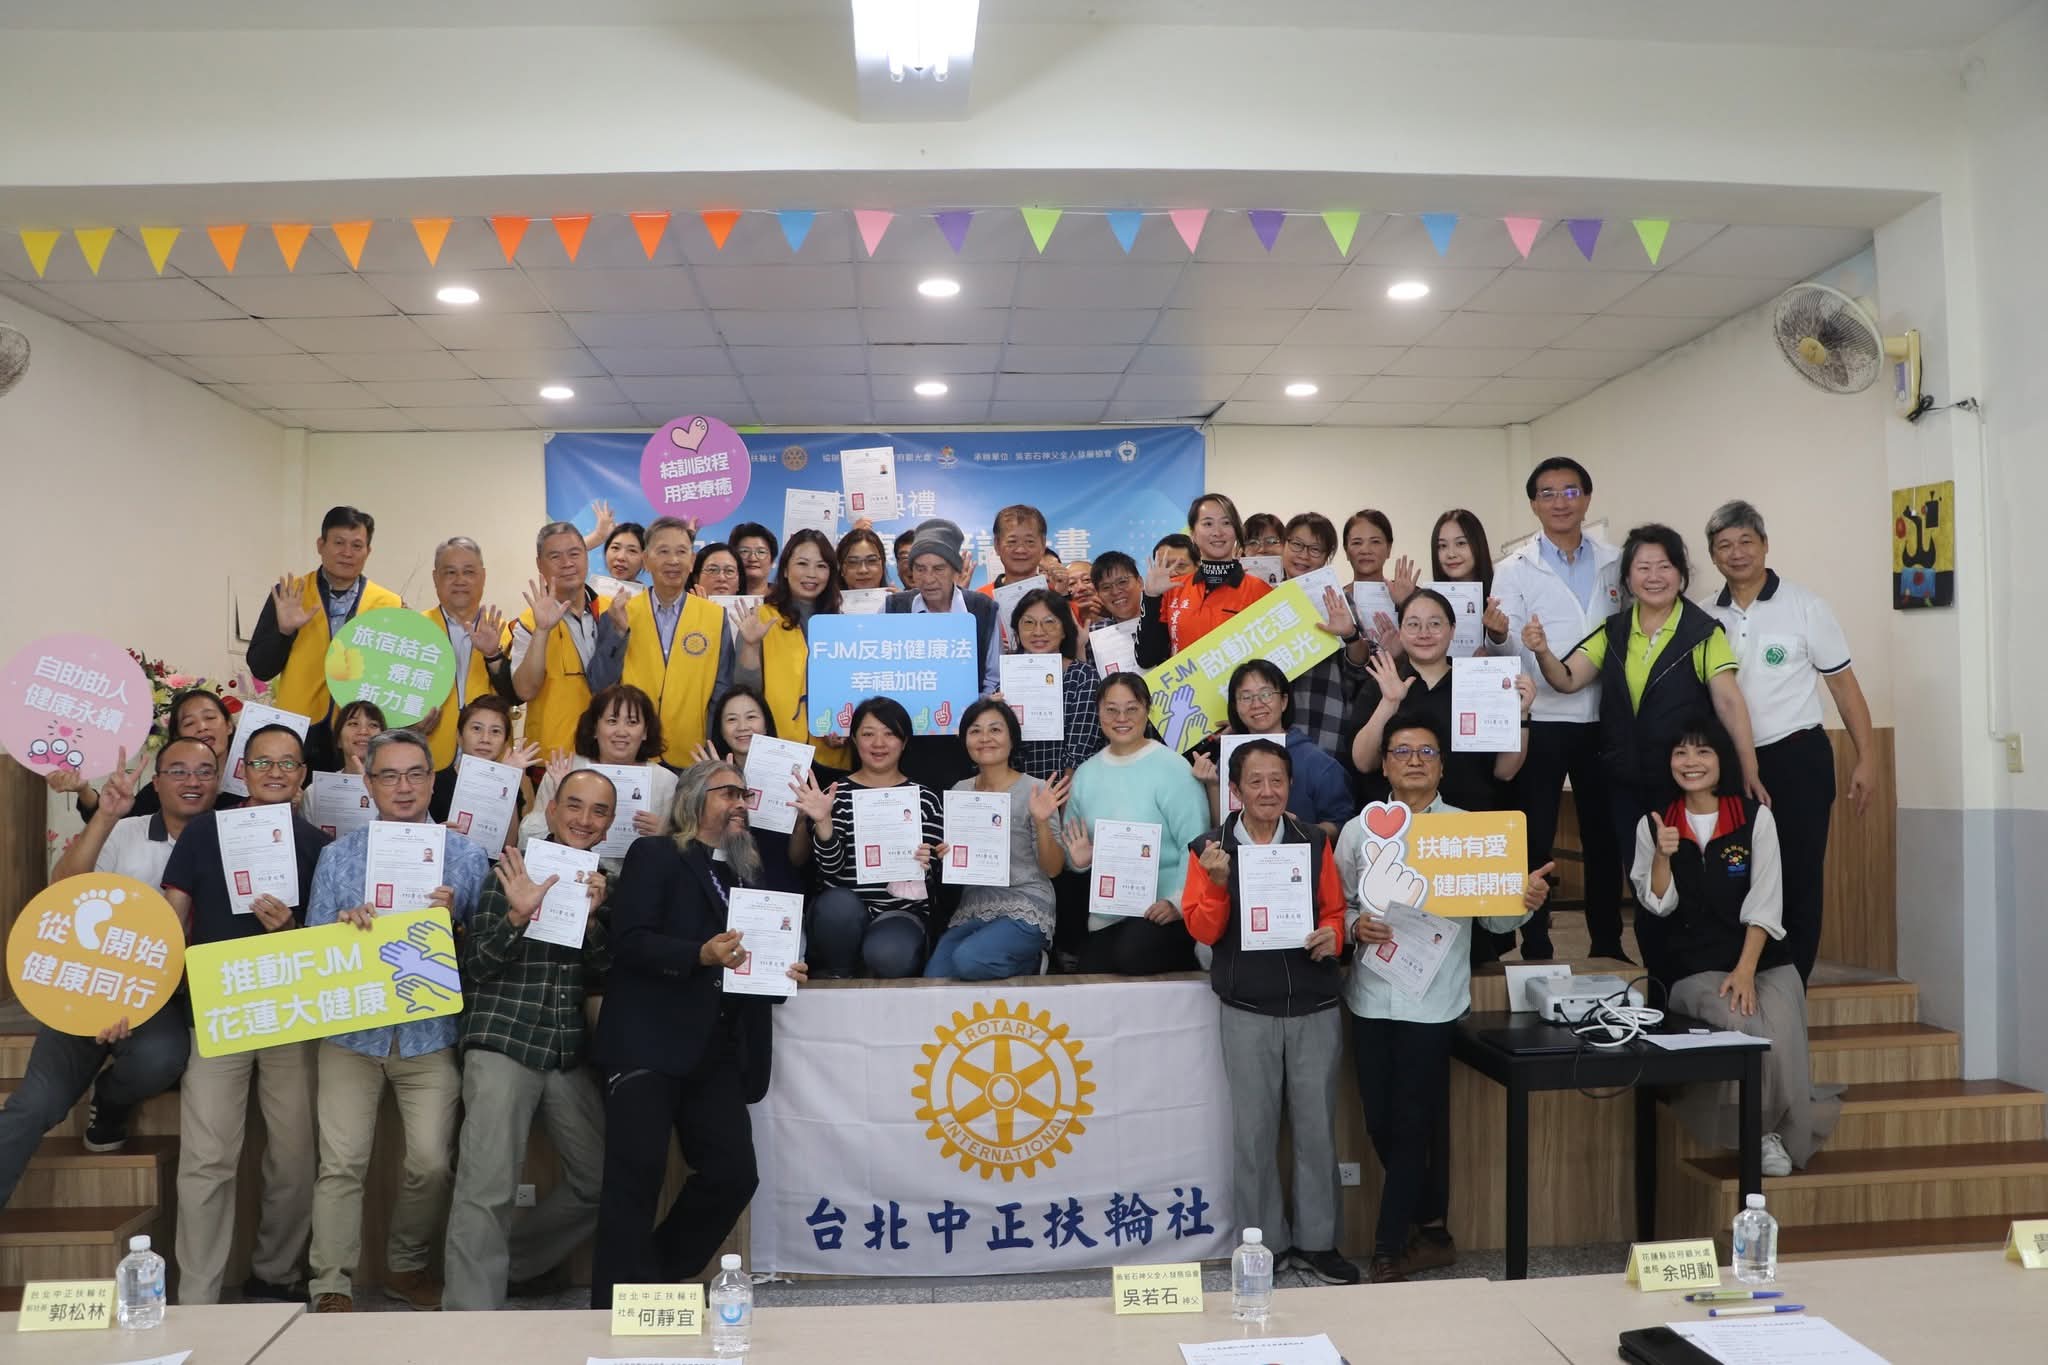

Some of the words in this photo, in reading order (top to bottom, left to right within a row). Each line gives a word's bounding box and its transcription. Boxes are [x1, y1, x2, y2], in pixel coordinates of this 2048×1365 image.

[659, 452, 730, 479] 結訓啟程
[664, 477, 733, 504] 用愛療癒
[351, 625, 442, 664] 旅宿結合
[813, 639, 972, 660] FJM反射健康法
[1198, 600, 1301, 680] 啟動花蓮
[33, 655, 128, 705] 自助助人
[387, 663, 435, 690] 療癒
[850, 670, 938, 692] 幸福加倍
[1159, 658, 1198, 690] FJM
[24, 683, 126, 734] 健康永續
[356, 683, 425, 717] 新力量
[1417, 834, 1508, 859] 扶輪有愛
[1432, 872, 1523, 897] 健康開懷
[36, 910, 72, 944] 從
[99, 926, 169, 969] 開始
[21, 951, 157, 1009] 健康同行
[220, 943, 363, 996] 推動FJM
[205, 982, 389, 1044] 花蓮大健康
[964, 1020, 1040, 1042] ROTARY
[944, 1117, 1069, 1162] INTERNATIONAL
[805, 1186, 1215, 1254] 台北中正扶輪社
[1641, 1247, 1711, 1261] 花蓮縣政府觀光處
[1662, 1260, 1714, 1282] 余明勳
[618, 1291, 697, 1301] 台北中正扶輪社
[1123, 1287, 1179, 1307] 吳若石
[1182, 1295, 1199, 1305] 神父
[49, 1302, 107, 1321] 郭松林
[618, 1308, 636, 1317] 社長
[638, 1308, 695, 1327] 何靜宜
